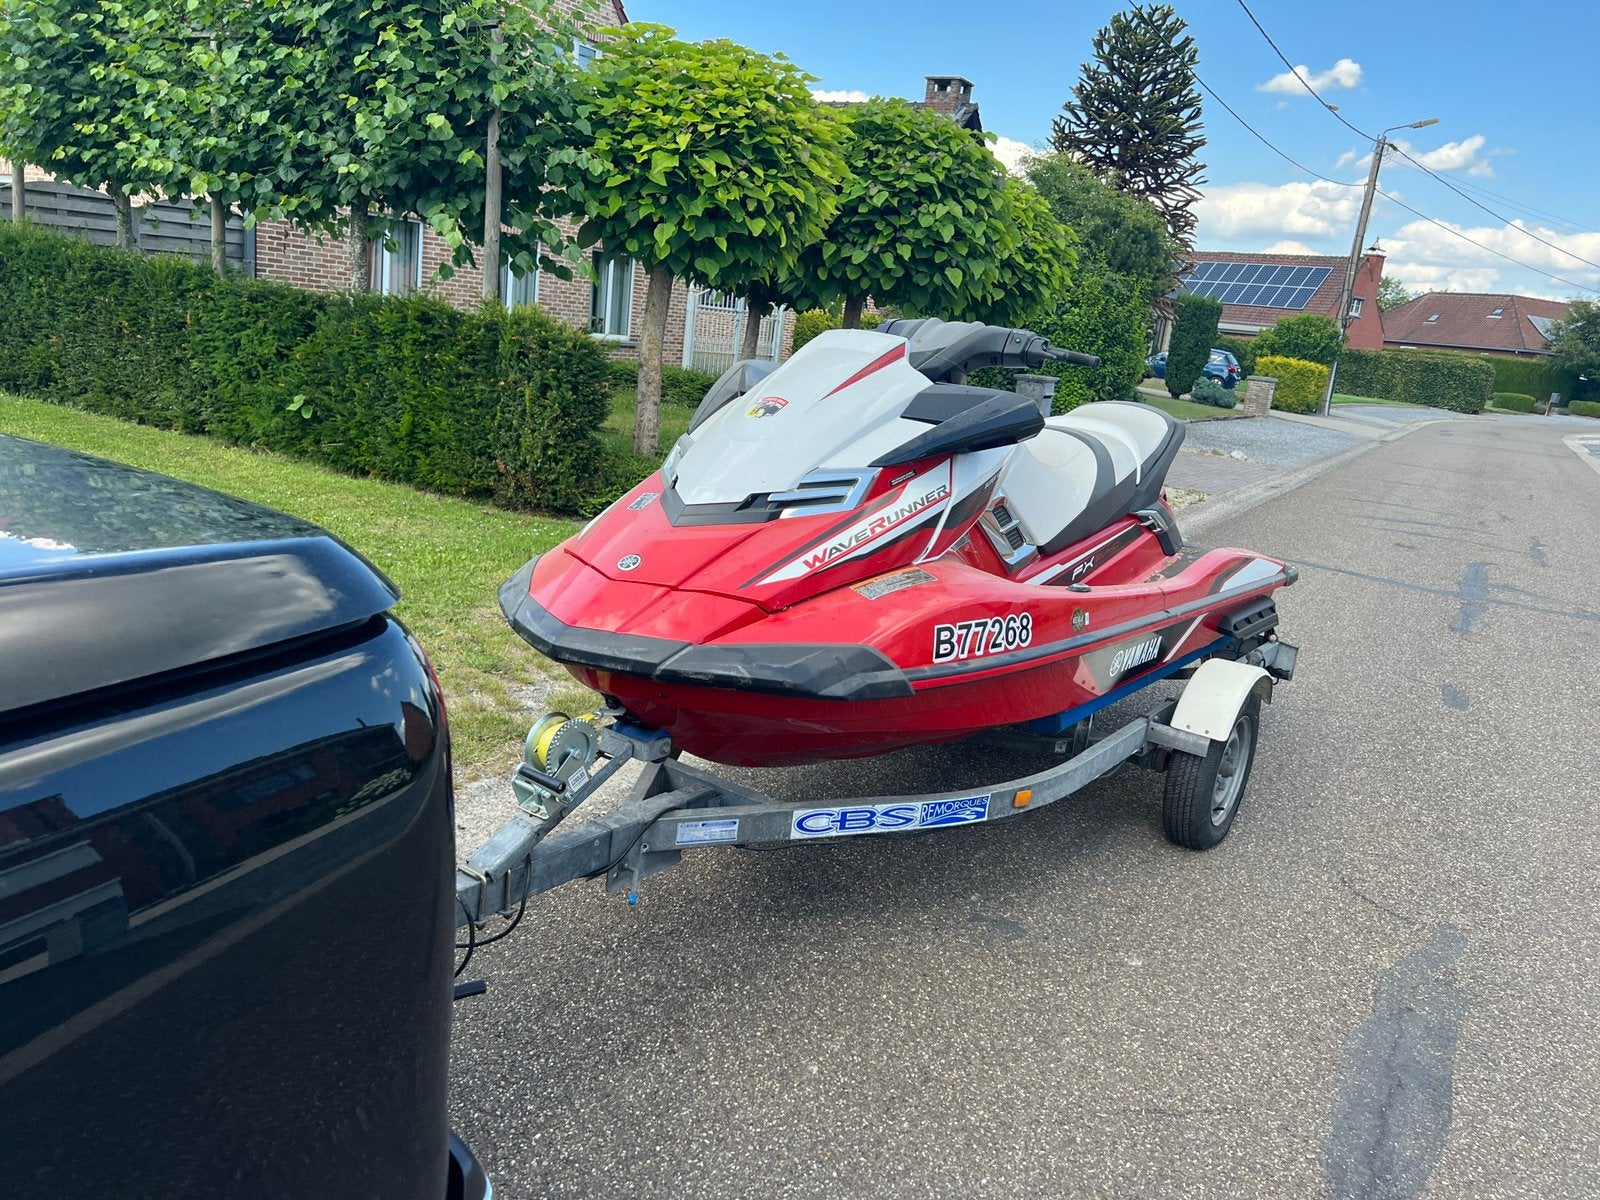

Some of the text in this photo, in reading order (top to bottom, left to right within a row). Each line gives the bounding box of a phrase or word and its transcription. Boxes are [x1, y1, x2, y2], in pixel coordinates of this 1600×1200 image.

[803, 484, 949, 569] WAVERUNNER
[1072, 556, 1095, 581] FX
[933, 612, 1032, 662] B77268
[1120, 636, 1163, 672] YAMAHA
[796, 797, 988, 835] CBS REMORQUES
